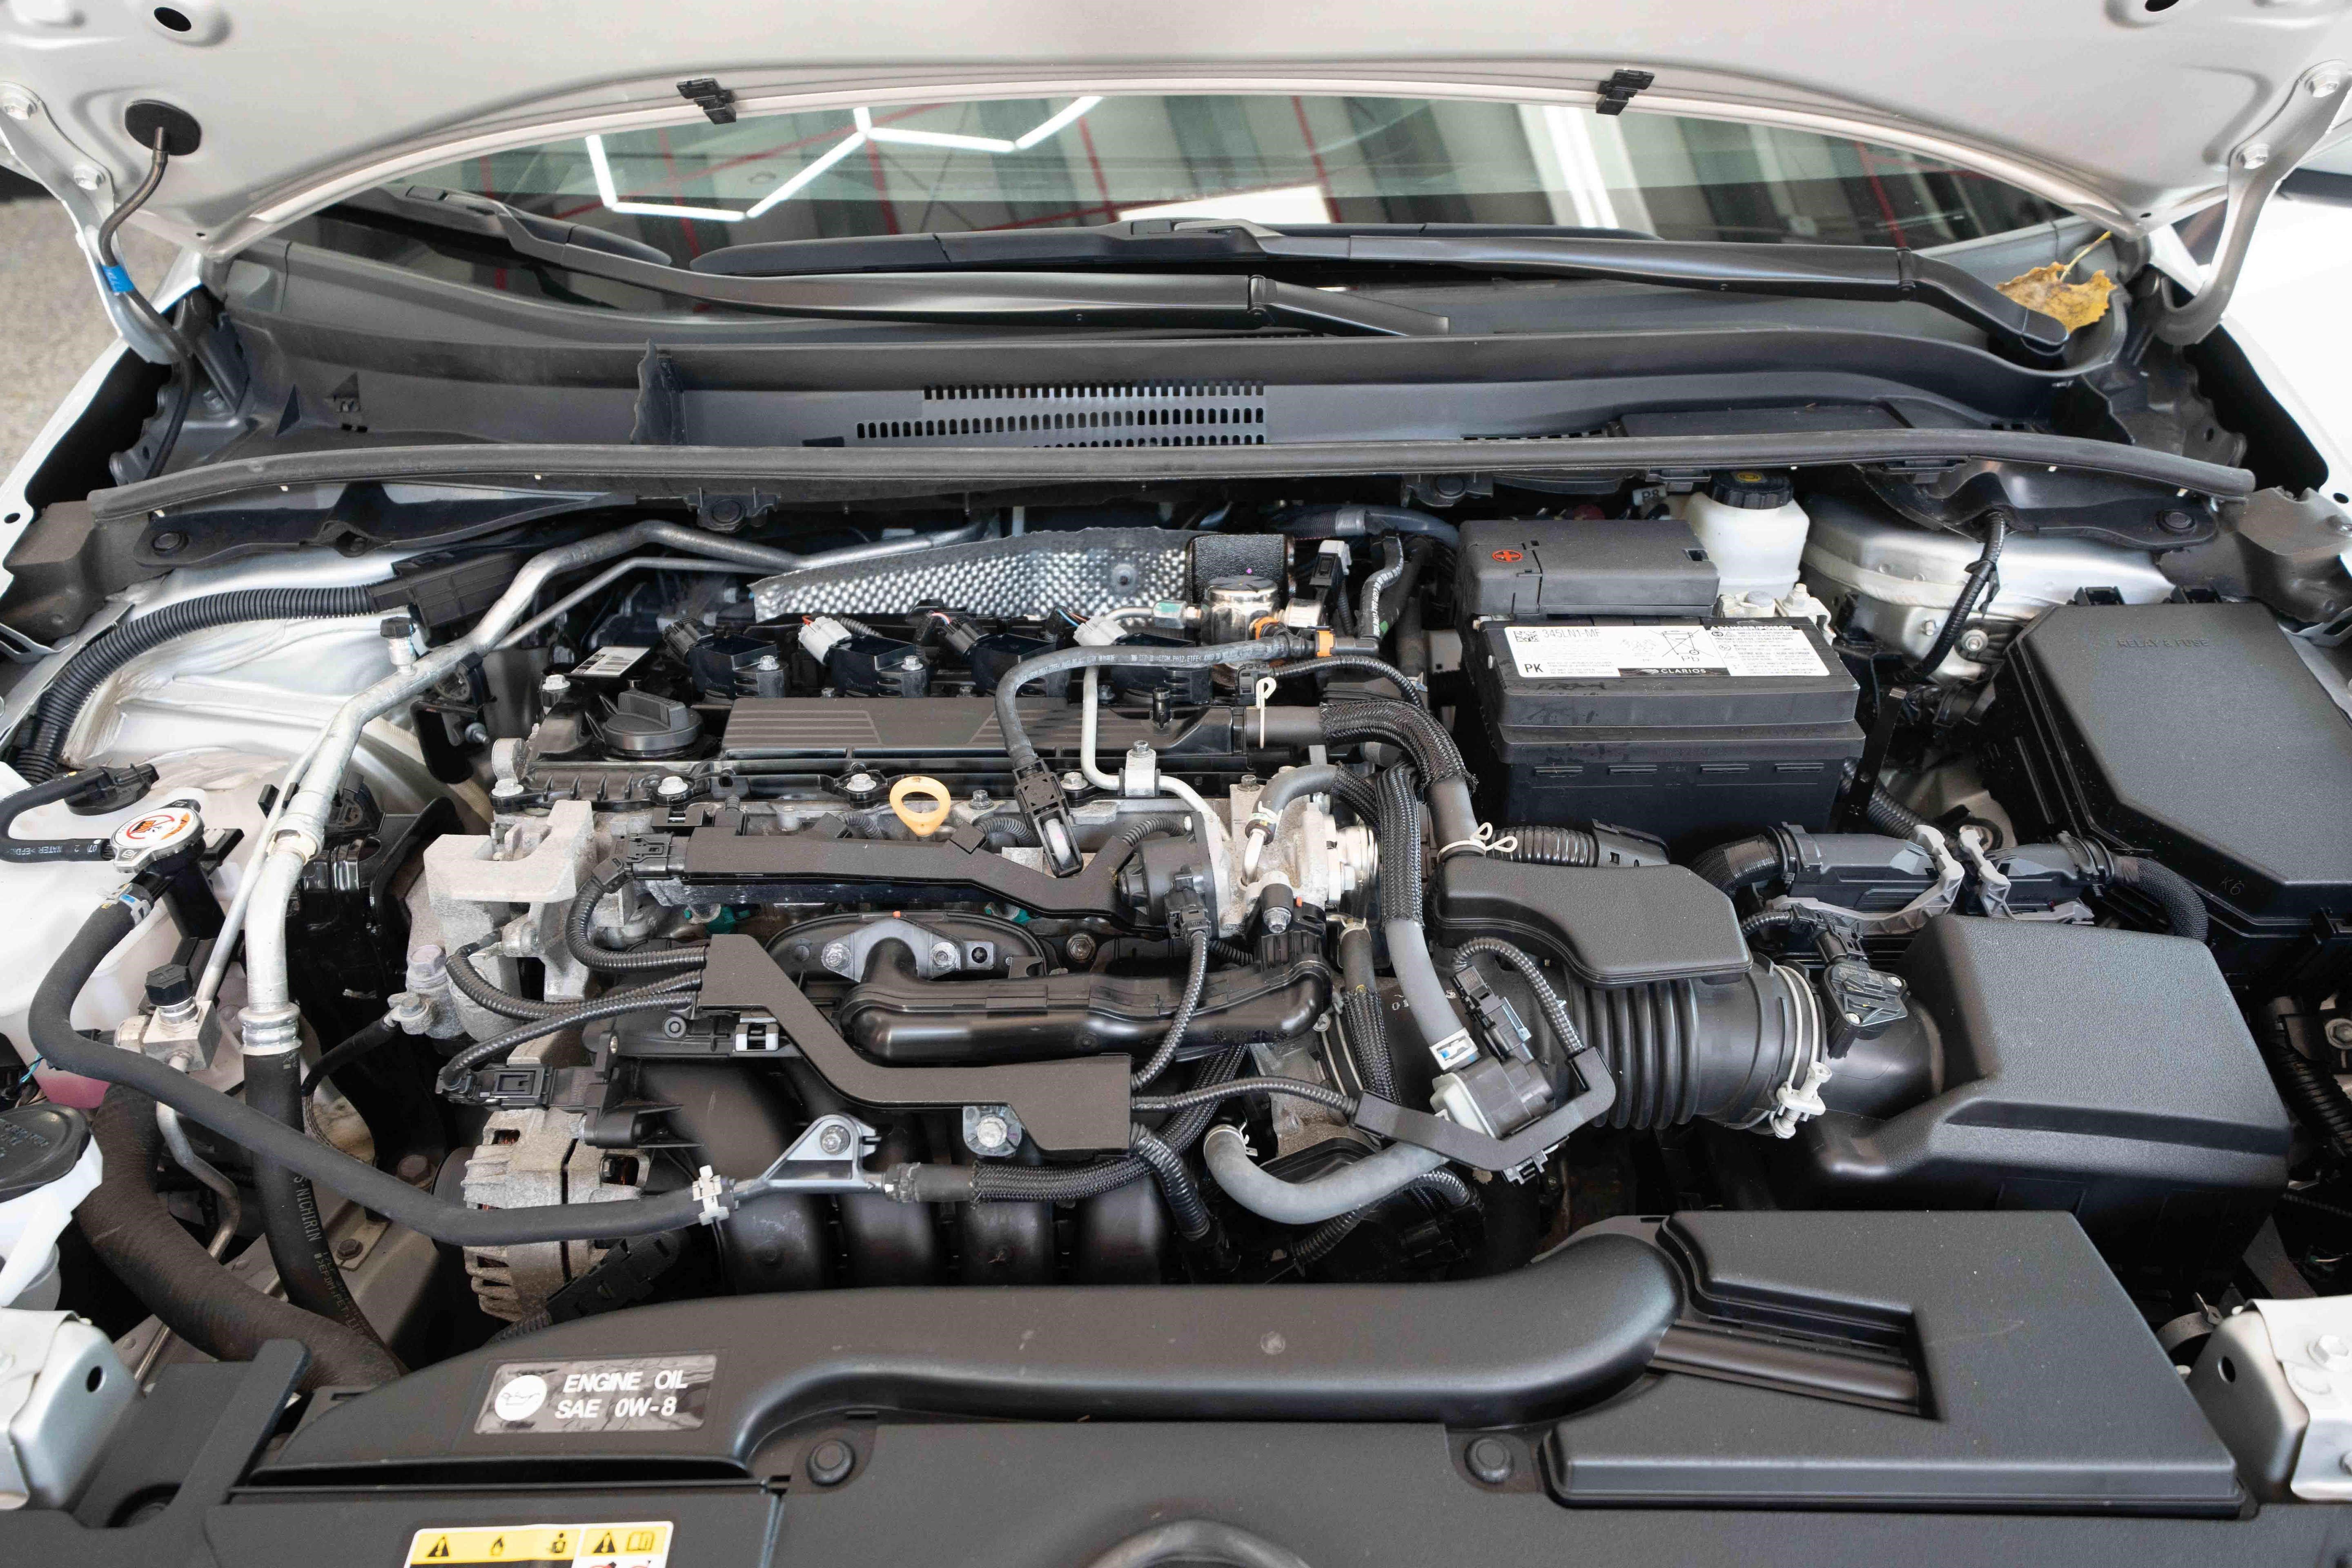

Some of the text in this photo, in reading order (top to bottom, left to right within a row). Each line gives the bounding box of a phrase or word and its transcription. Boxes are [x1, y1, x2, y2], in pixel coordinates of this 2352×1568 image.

[1542, 629, 1601, 637] 345LN1-MF
[2117, 638, 2159, 648] RELAY
[2174, 638, 2209, 648] FUSE
[1524, 664, 1543, 673] PK
[562, 1370, 688, 1393] ENGINE OIL
[555, 1396, 677, 1419] SAE 0W-8
